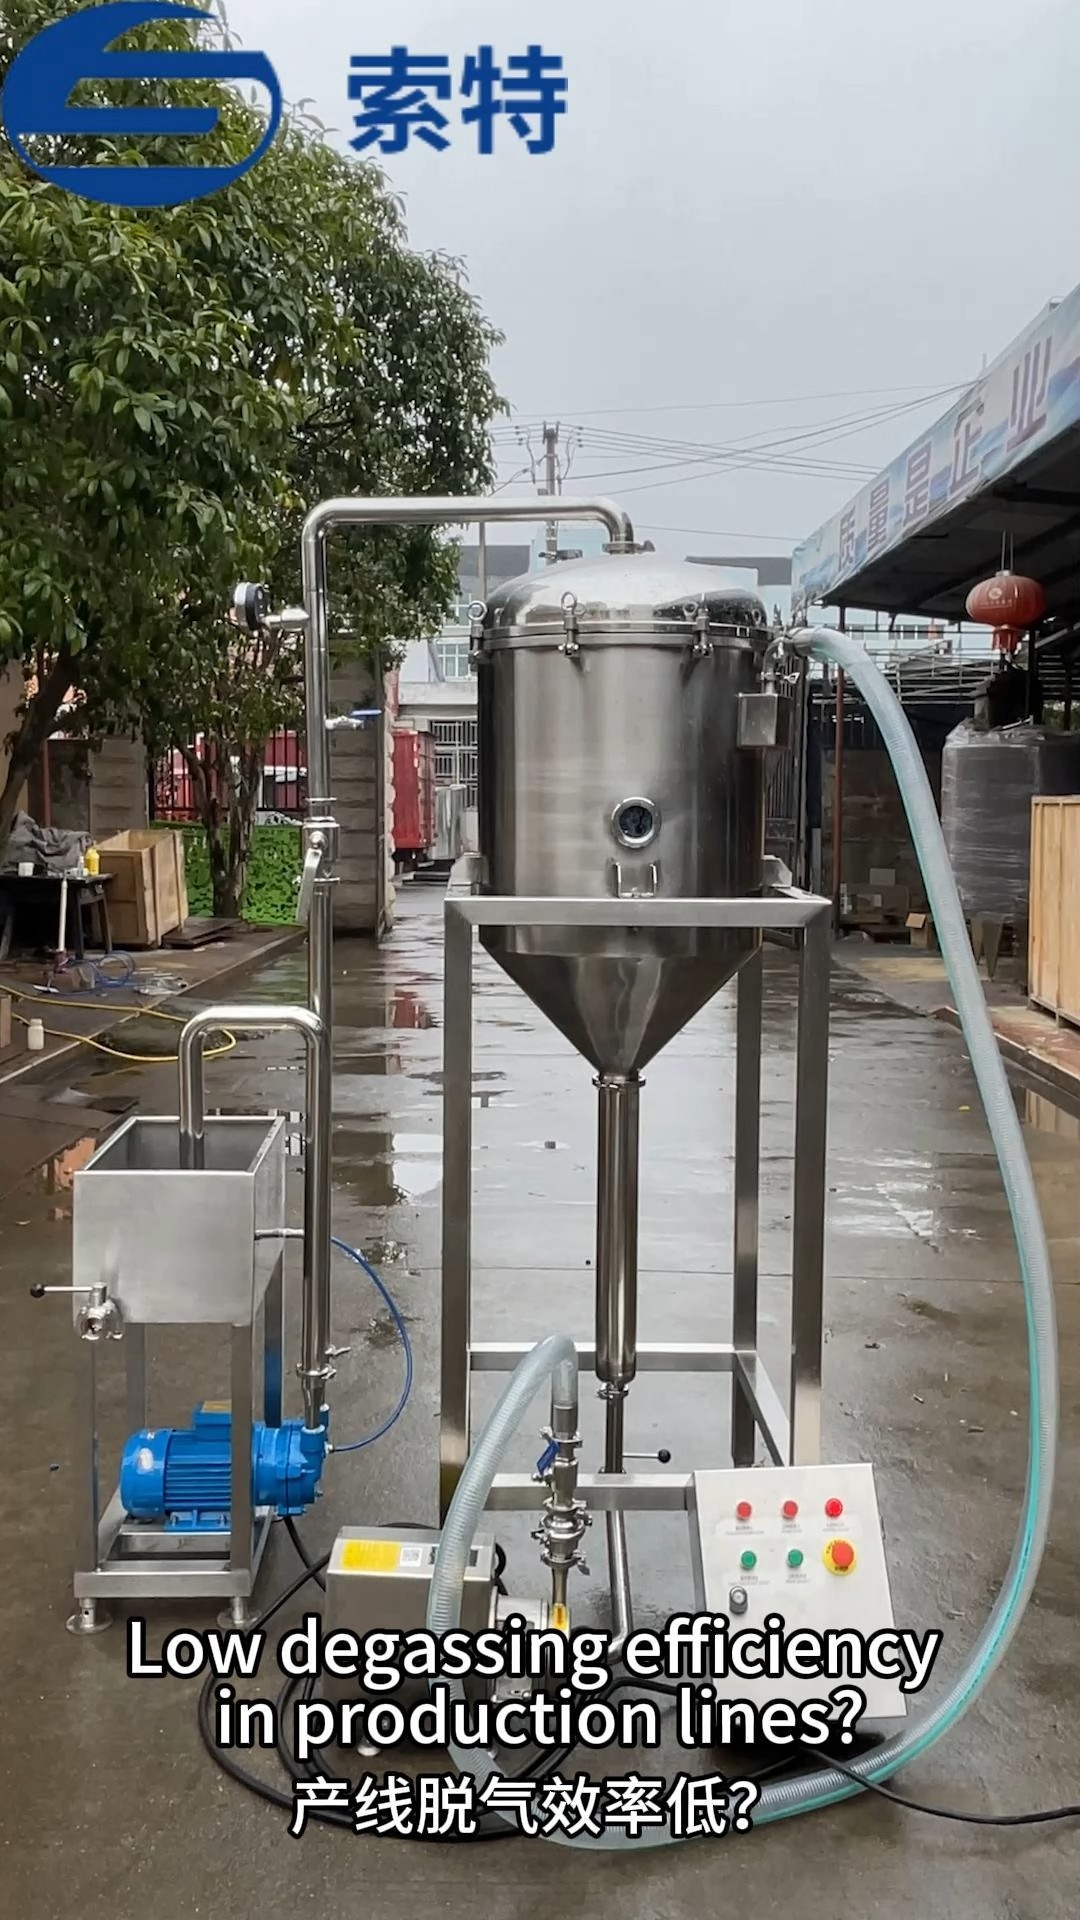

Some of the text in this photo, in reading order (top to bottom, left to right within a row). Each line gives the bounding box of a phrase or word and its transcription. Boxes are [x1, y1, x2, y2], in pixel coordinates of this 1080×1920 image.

[837, 334, 1054, 574] 质量是企业
